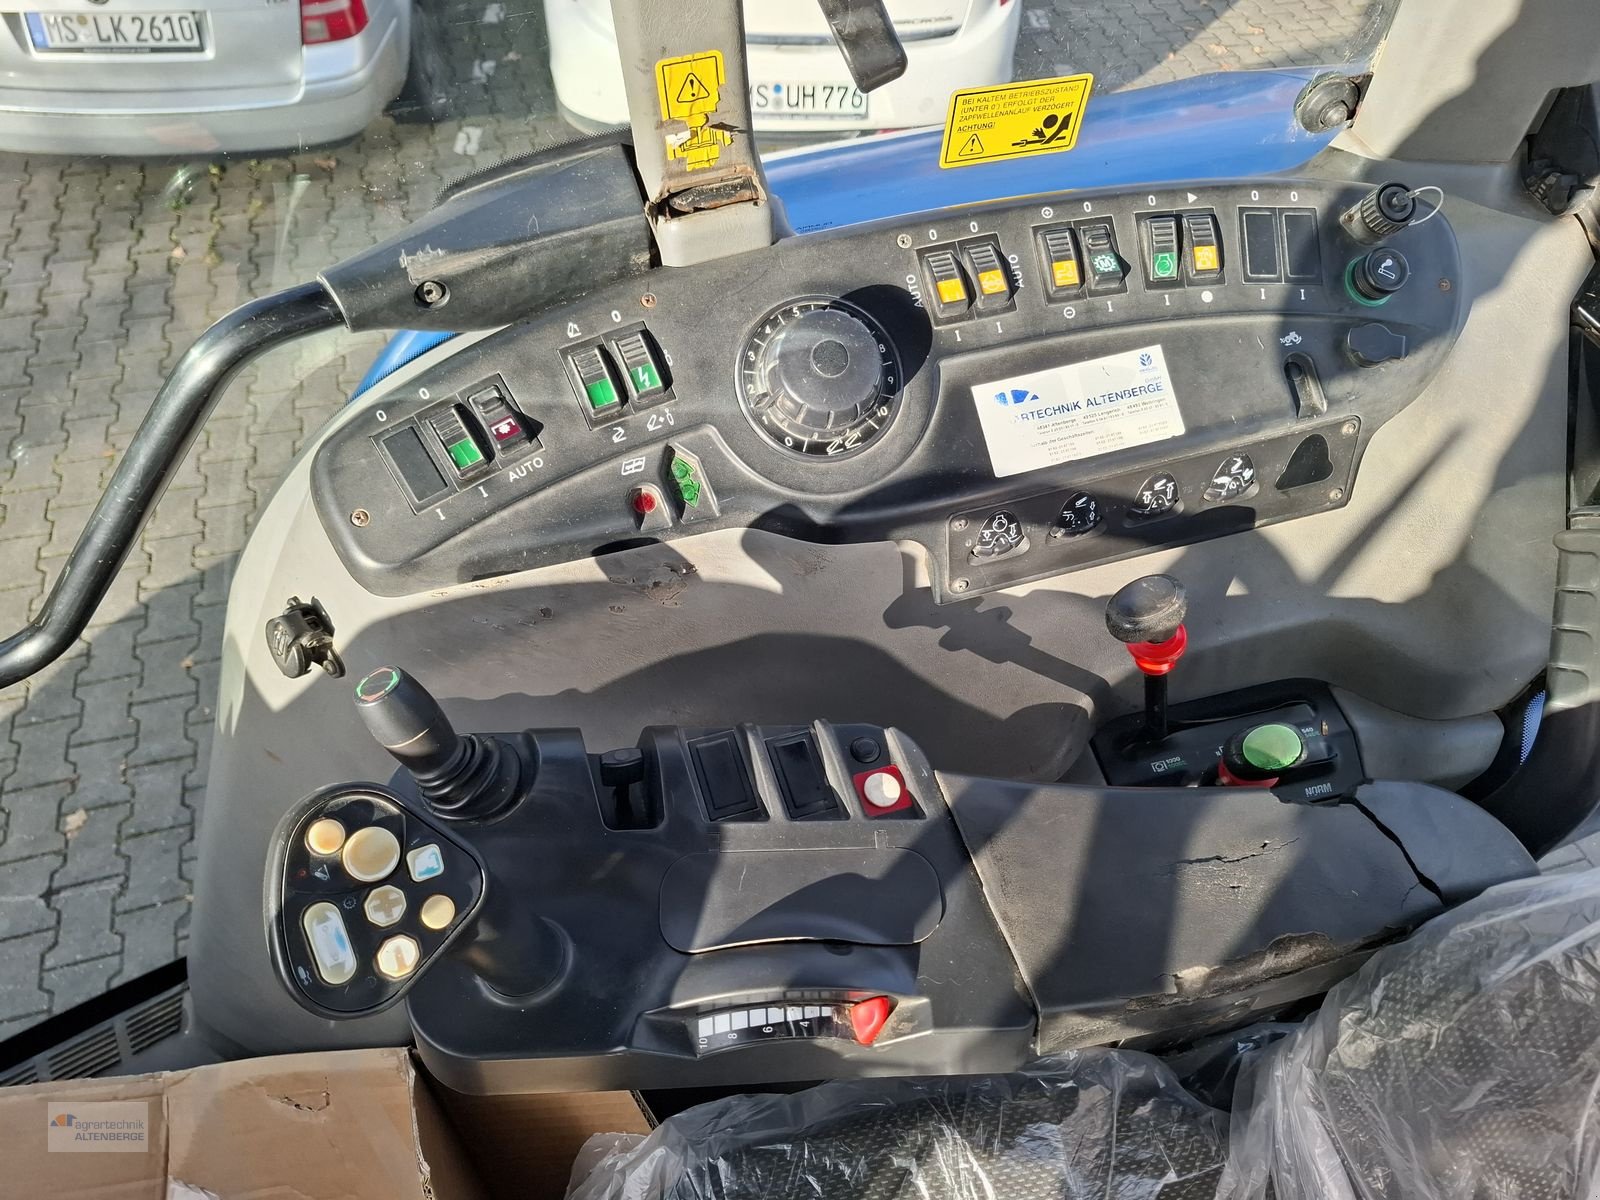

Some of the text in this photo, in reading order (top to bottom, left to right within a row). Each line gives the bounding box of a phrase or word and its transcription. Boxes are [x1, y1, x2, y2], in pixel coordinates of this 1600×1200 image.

[44, 14, 194, 43] MS LK 2610
[786, 85, 815, 109] UH
[823, 85, 863, 109] 776
[962, 84, 1080, 106] BEI KALTEM BETRIEBSZUSTAND
[1002, 98, 1038, 109] ERFOLGT
[1039, 95, 1056, 104] DER
[959, 107, 1031, 123] ZAPFWELLENANLAUF
[957, 121, 996, 133] ACHTUNG!
[878, 343, 886, 353] 8
[748, 351, 756, 361] 3
[1086, 382, 1165, 408] ALTENBERGE
[508, 457, 545, 482] AUTO
[1304, 783, 1333, 797] NORM
[727, 1031, 738, 1041] 8
[698, 1037, 709, 1050] 10
